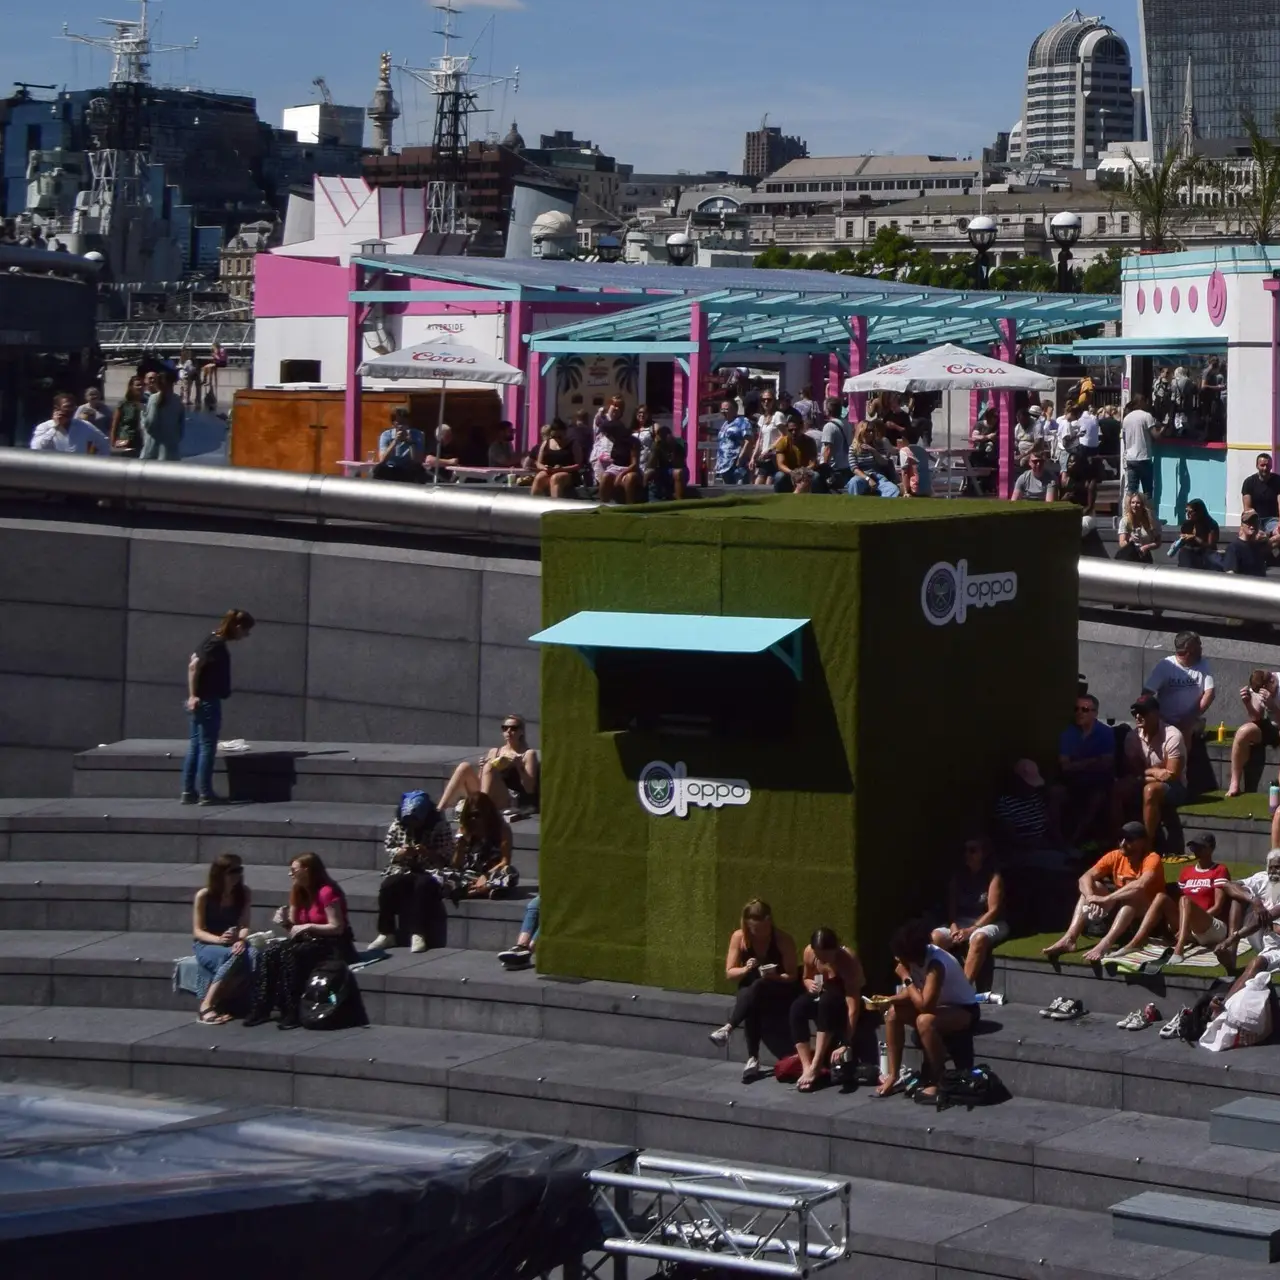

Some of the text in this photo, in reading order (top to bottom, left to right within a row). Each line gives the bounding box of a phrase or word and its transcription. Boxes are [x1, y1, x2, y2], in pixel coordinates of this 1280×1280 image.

[412, 352, 477, 363] Coors
[946, 364, 1006, 374] Coors
[967, 578, 1014, 601] oppo
[687, 783, 746, 801] oppo
